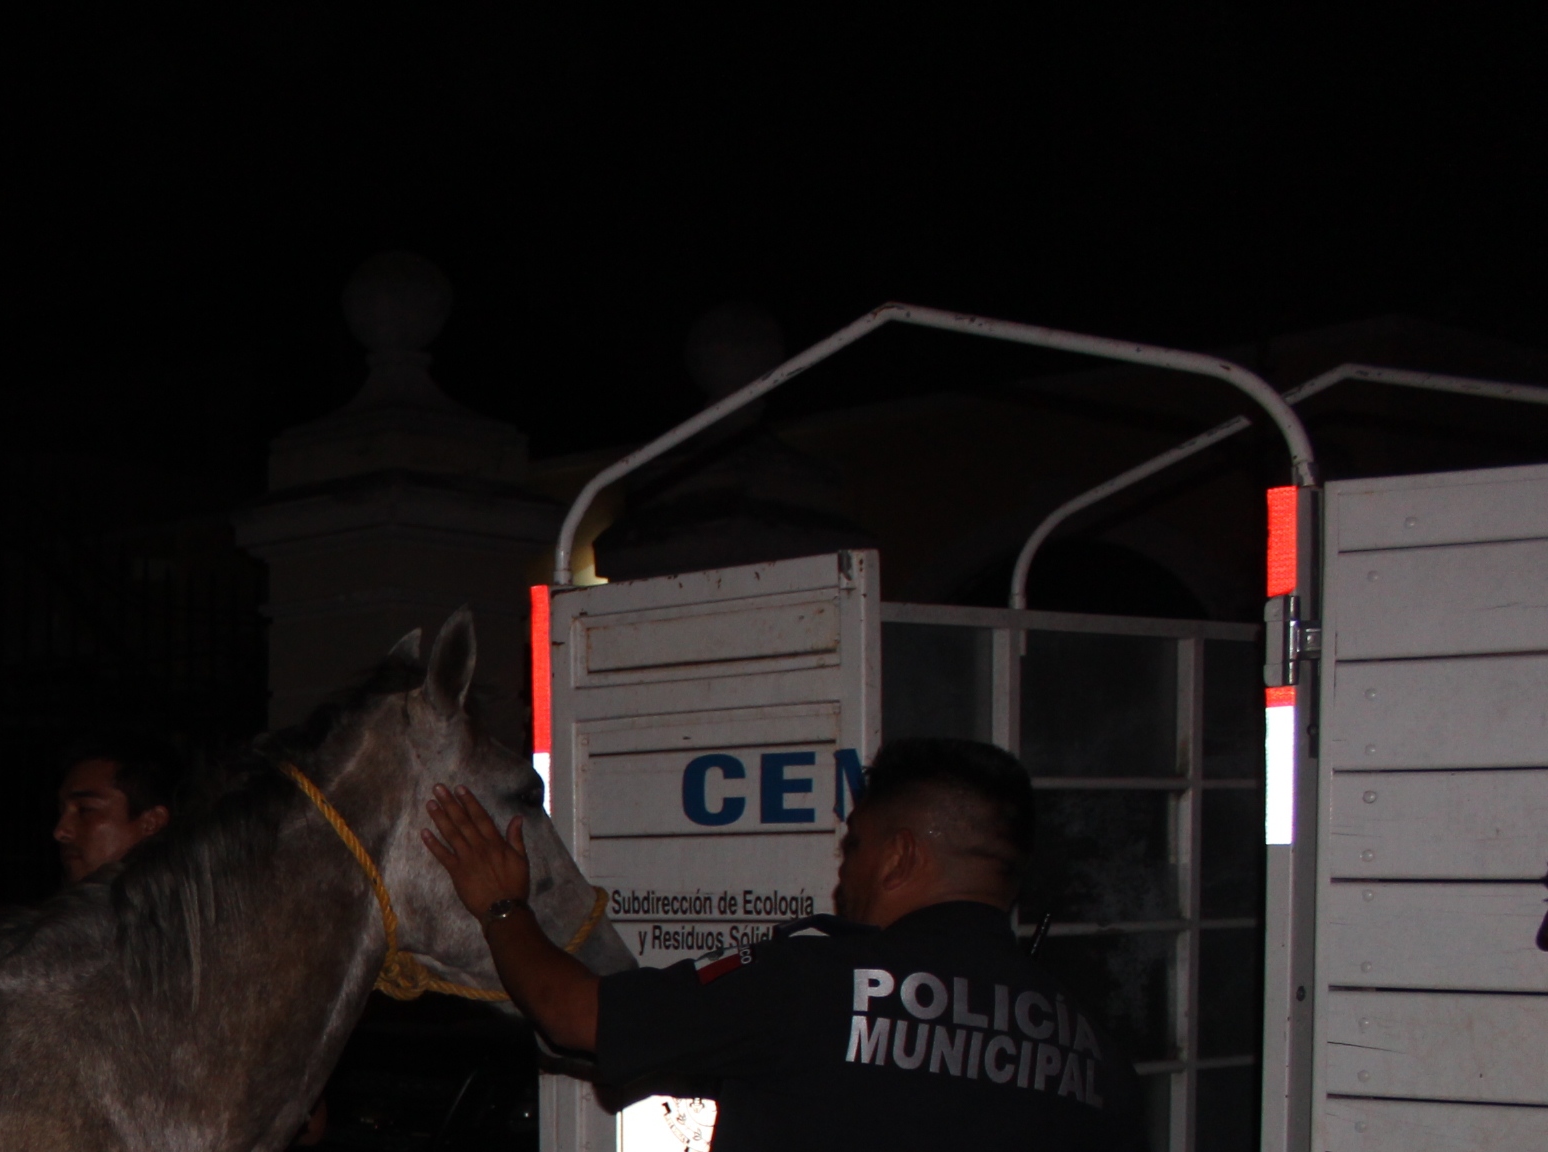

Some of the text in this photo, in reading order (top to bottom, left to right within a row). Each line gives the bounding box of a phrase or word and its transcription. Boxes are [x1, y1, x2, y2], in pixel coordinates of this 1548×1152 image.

[612, 888, 814, 919] Subdirección de Ecología
[638, 931, 647, 956] y
[652, 925, 723, 950] Residuos
[845, 1014, 1104, 1110] MUNICIPAL
